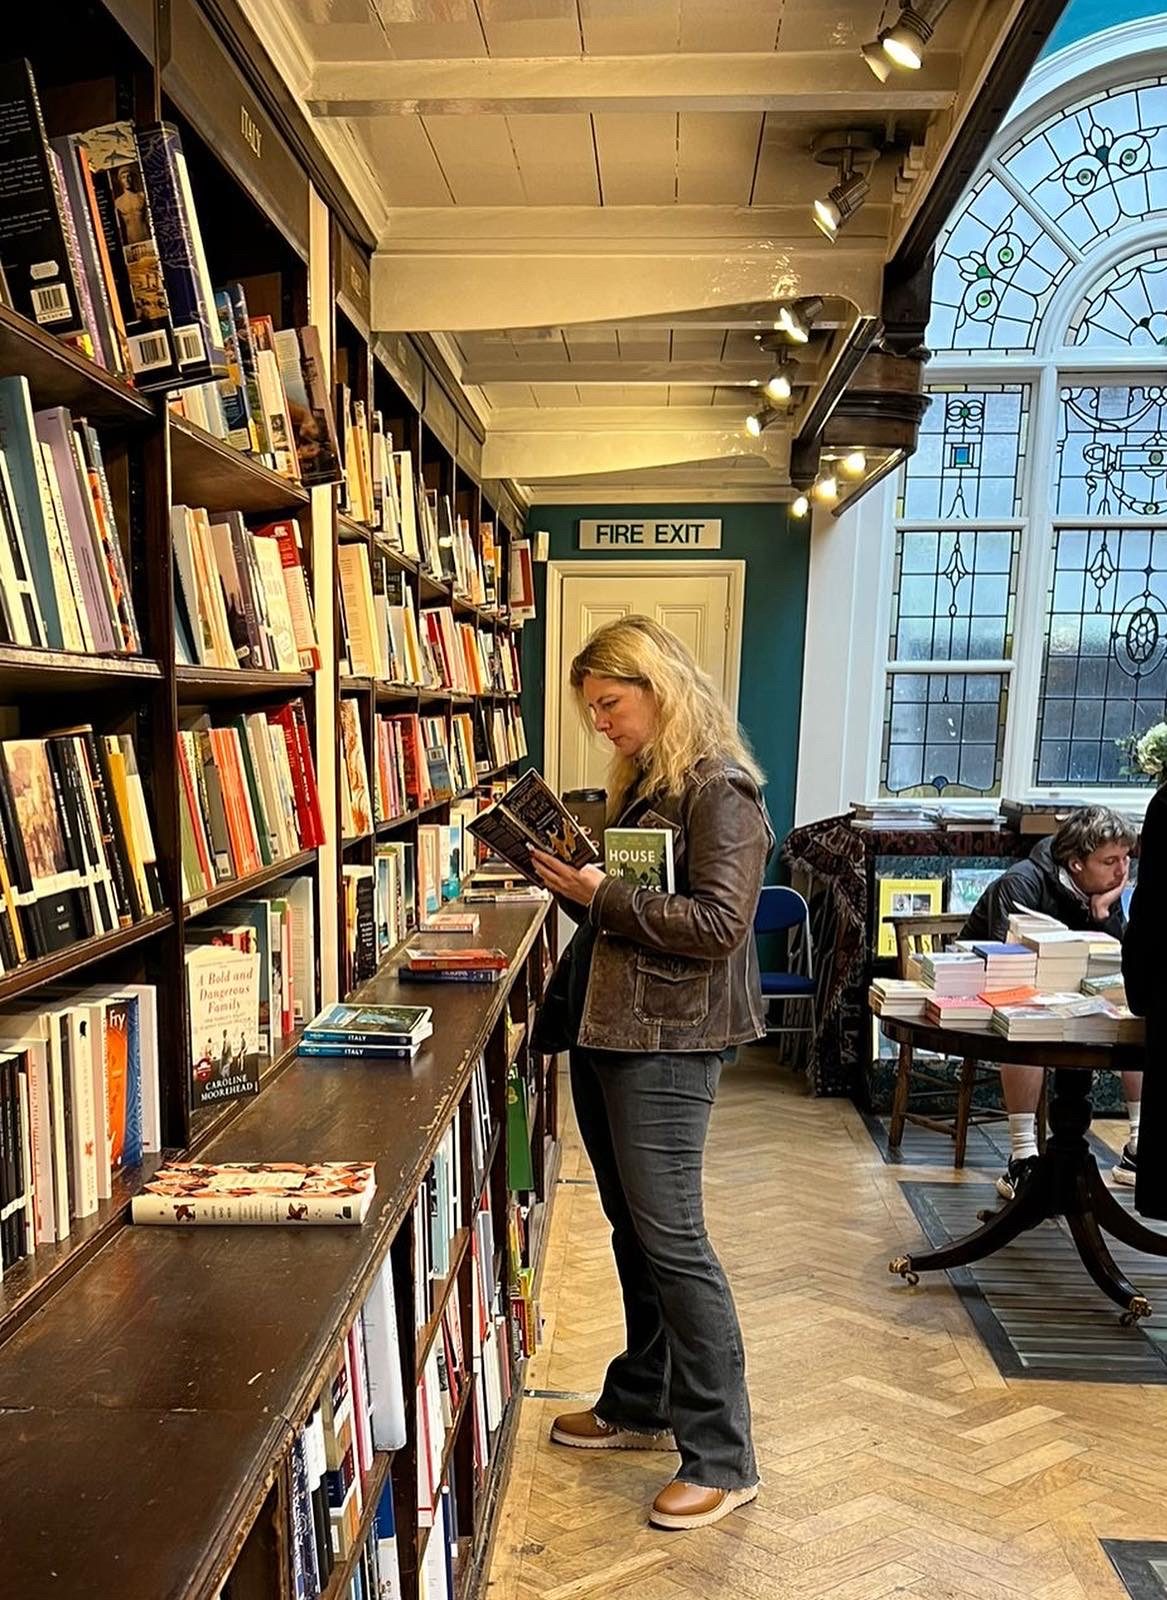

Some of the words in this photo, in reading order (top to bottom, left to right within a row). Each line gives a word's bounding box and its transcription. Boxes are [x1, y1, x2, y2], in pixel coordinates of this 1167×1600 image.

[596, 524, 644, 544] FIRE
[655, 524, 705, 544] EXIT
[609, 849, 656, 863] HOUSE
[609, 868, 624, 878] ON
[197, 973, 205, 987] A
[208, 970, 231, 985] Bold
[232, 967, 254, 981] and
[200, 985, 250, 1001] Dangerous
[207, 998, 241, 1014] Family
[110, 1009, 126, 1031] Fry
[348, 1034, 367, 1042] ITALY
[344, 1048, 364, 1056] ITALY
[204, 1074, 248, 1091] CAROLINE
[200, 1082, 254, 1102] MOOREHEAD
